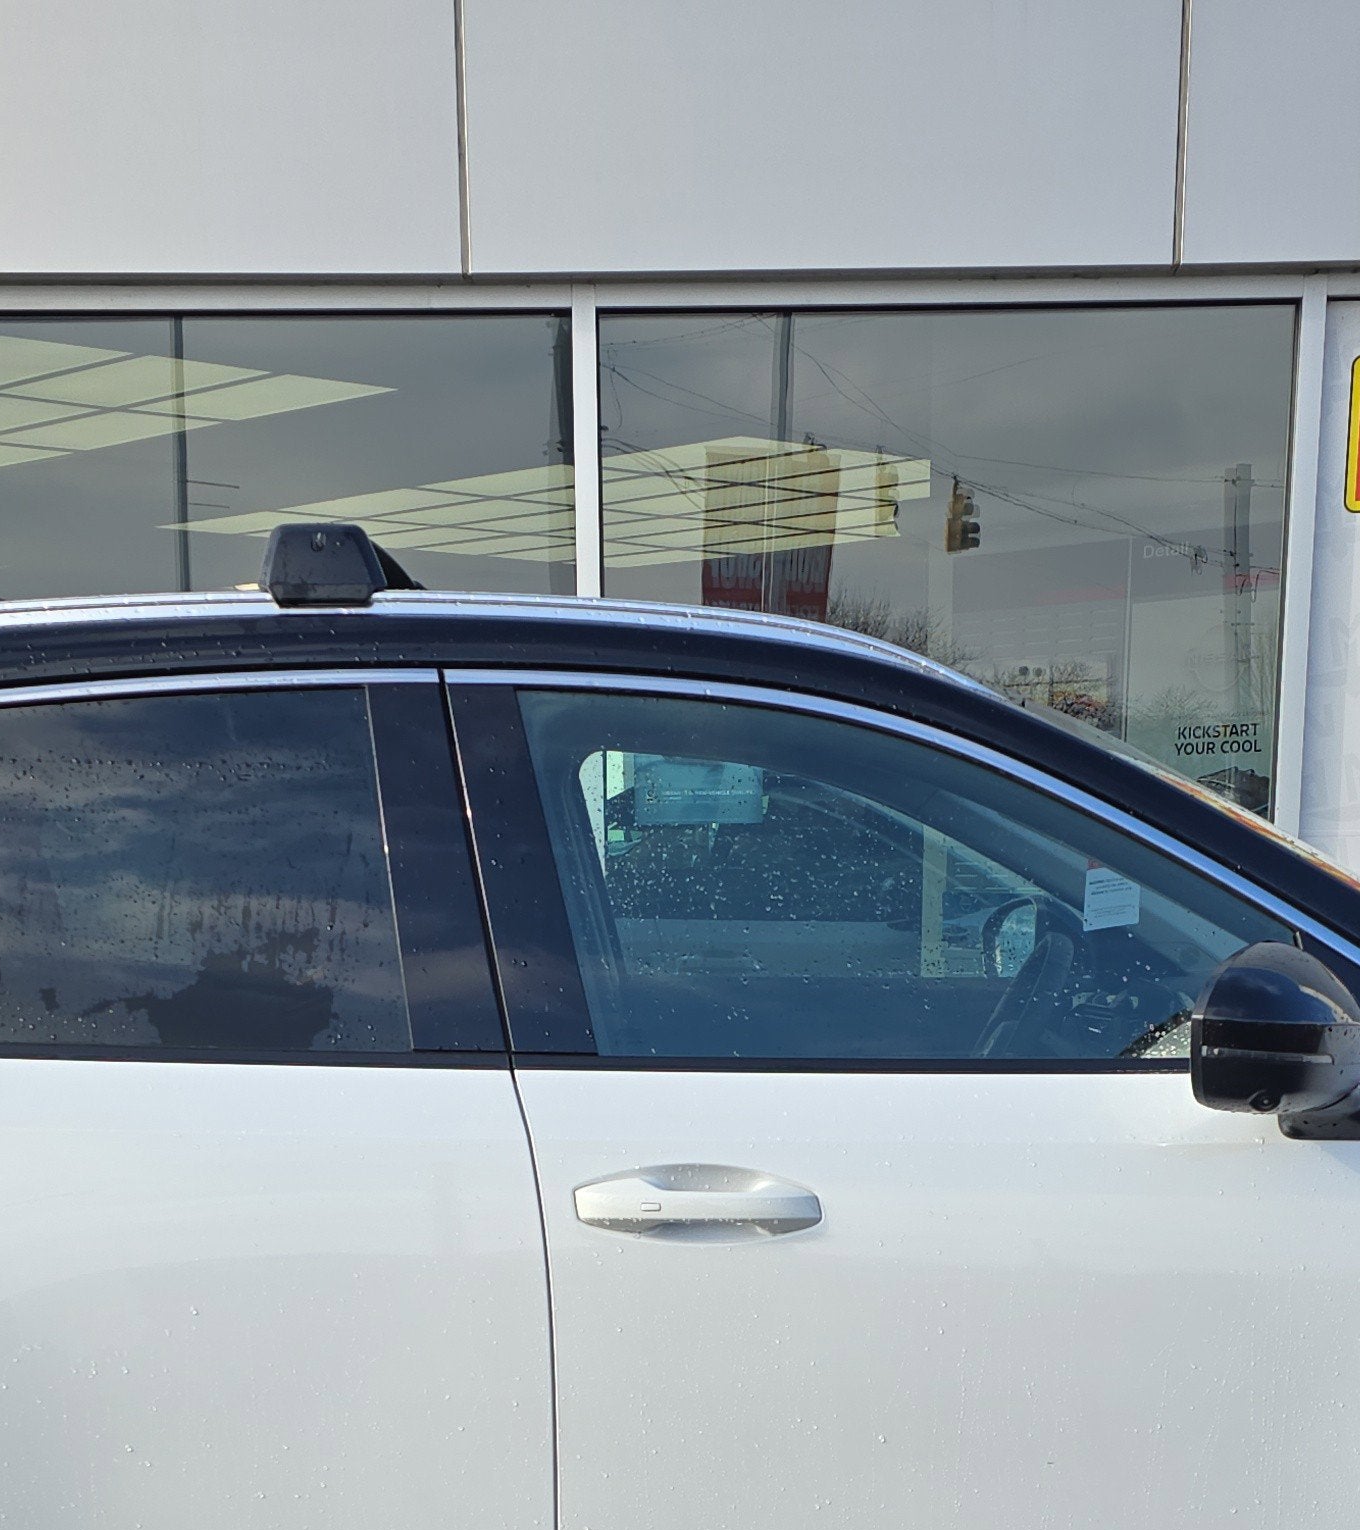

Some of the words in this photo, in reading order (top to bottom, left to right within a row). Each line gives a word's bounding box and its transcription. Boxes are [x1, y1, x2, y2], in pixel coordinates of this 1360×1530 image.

[1177, 723, 1260, 740] KICKSTART
[1174, 741, 1216, 756] YOUR
[1220, 739, 1262, 754] COOL
